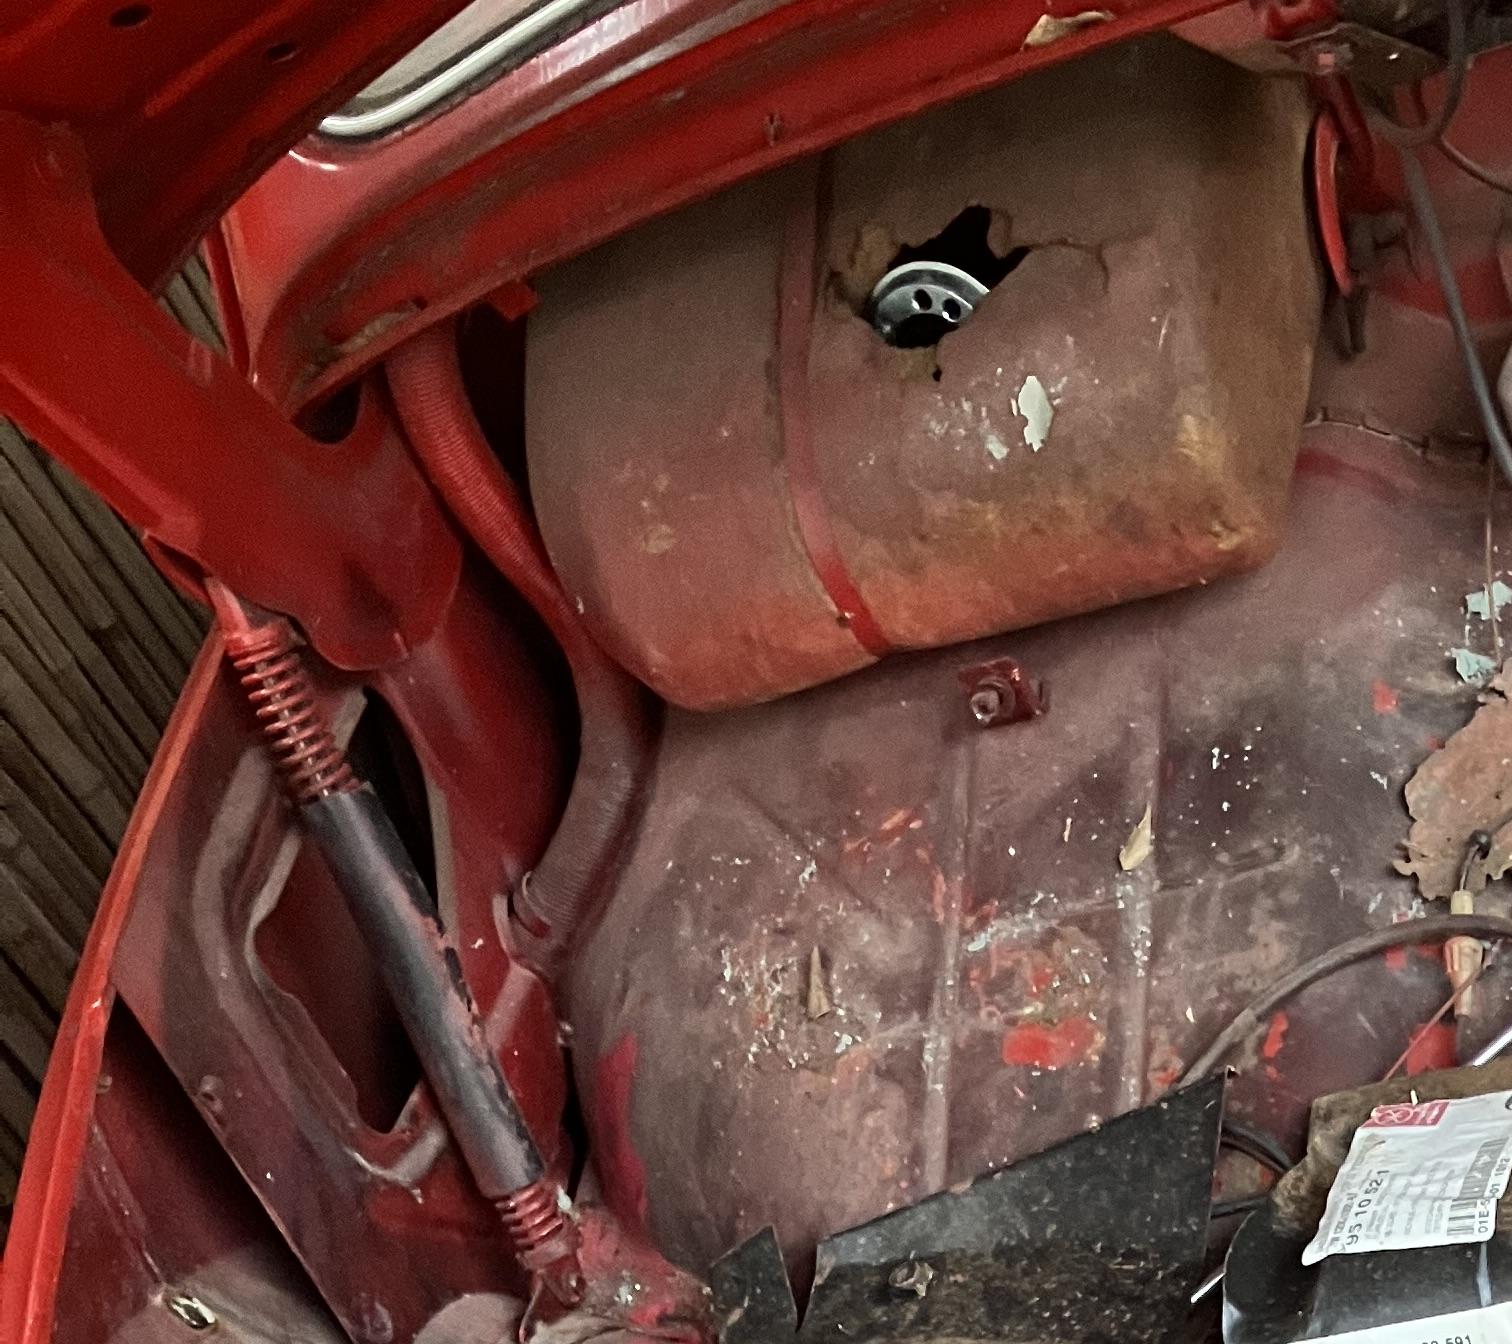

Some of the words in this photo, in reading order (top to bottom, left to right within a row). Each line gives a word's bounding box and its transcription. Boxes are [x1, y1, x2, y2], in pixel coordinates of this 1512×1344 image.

[1362, 1177, 1384, 1195] 52
[1352, 1197, 1372, 1217] 10
[1342, 1222, 1365, 1245] 95
